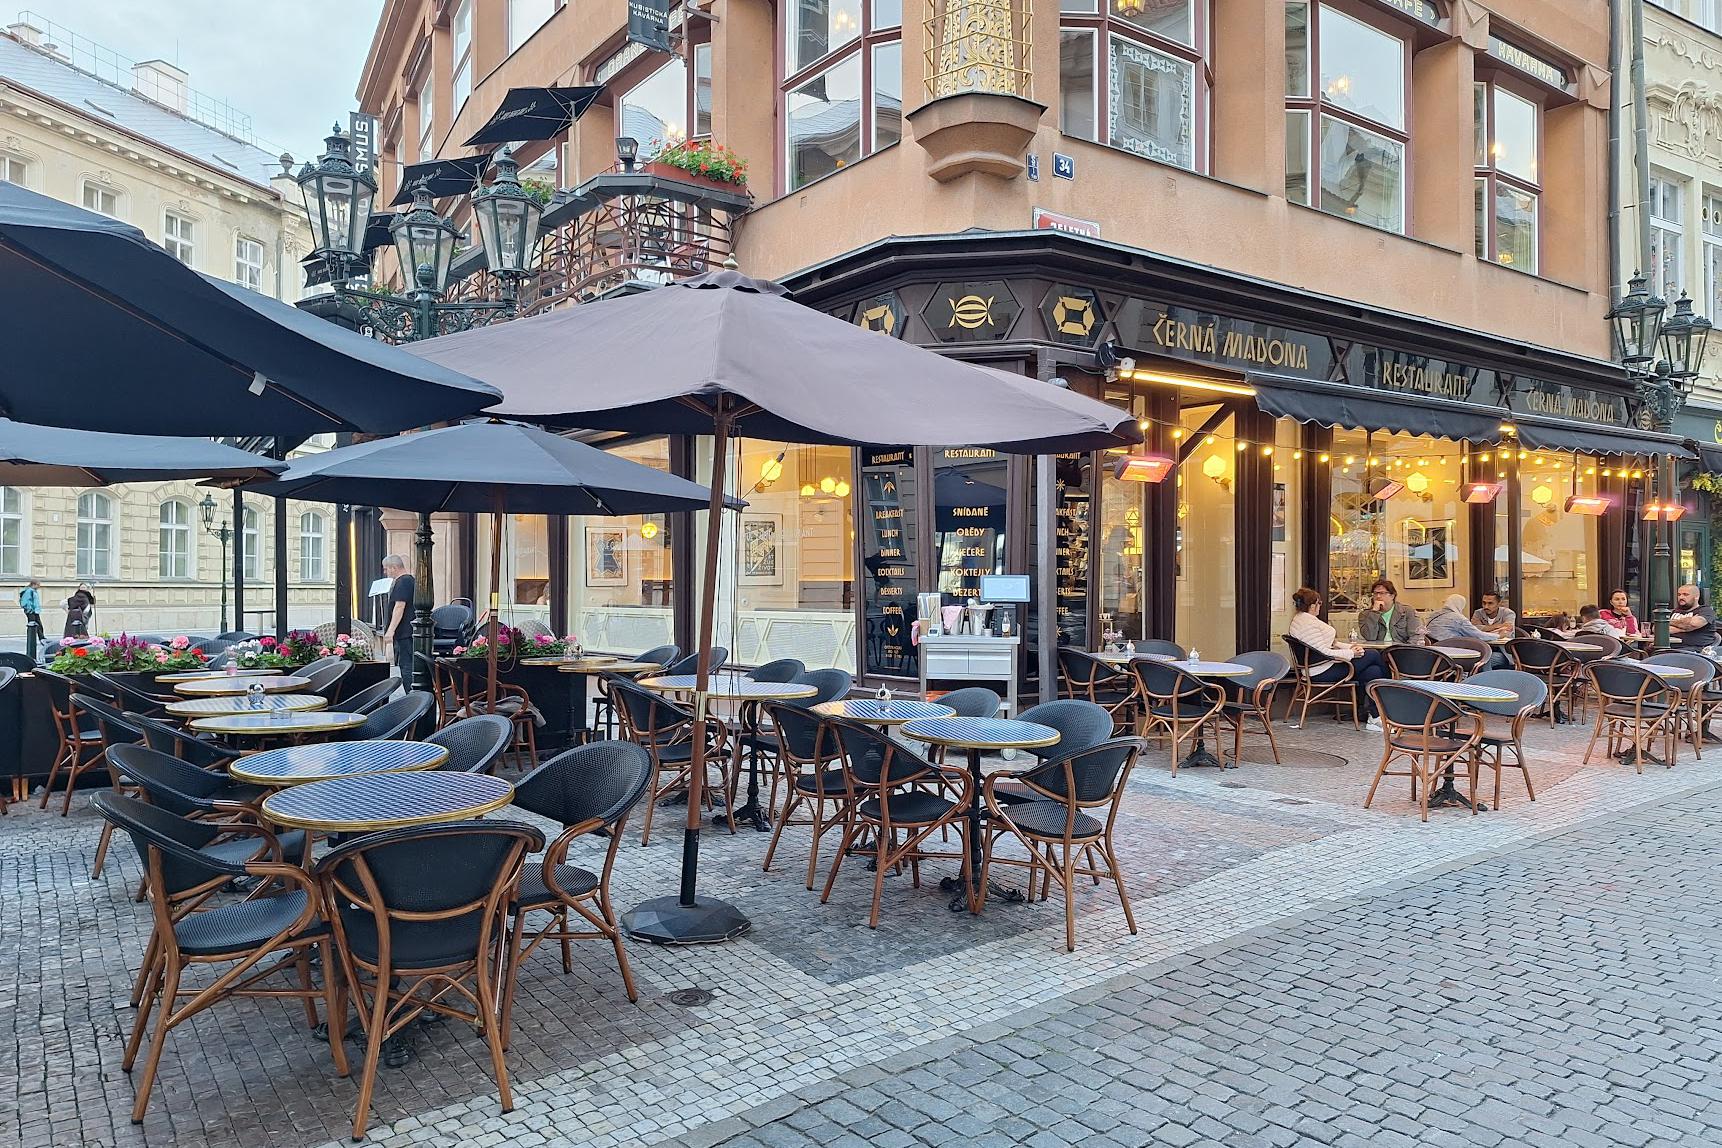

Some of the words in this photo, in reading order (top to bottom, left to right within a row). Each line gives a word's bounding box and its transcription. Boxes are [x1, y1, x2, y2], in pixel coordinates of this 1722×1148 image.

[1059, 158, 1071, 174] 34
[1152, 312, 1217, 355] ČERNÁ
[1222, 331, 1309, 370] MADONA
[1382, 361, 1470, 398] RESTAURANT
[1526, 386, 1561, 414] ČERNÁ
[1565, 397, 1614, 423] MADONA
[871, 451, 905, 465] RESTAURANT
[944, 449, 996, 458] RESTAURANT
[875, 508, 904, 519] BREAKFAST
[952, 506, 989, 517] SNÍDANĚ
[881, 529, 899, 538] LUNCH
[956, 526, 985, 537] OBĚDY
[880, 549, 901, 557] DINNER
[877, 567, 905, 576] COCKTAILS
[950, 568, 991, 577] KOKTEJLY
[880, 587, 903, 596] DESSERTS
[952, 588, 982, 597] DEZERT
[882, 606, 903, 615] COFFEE
